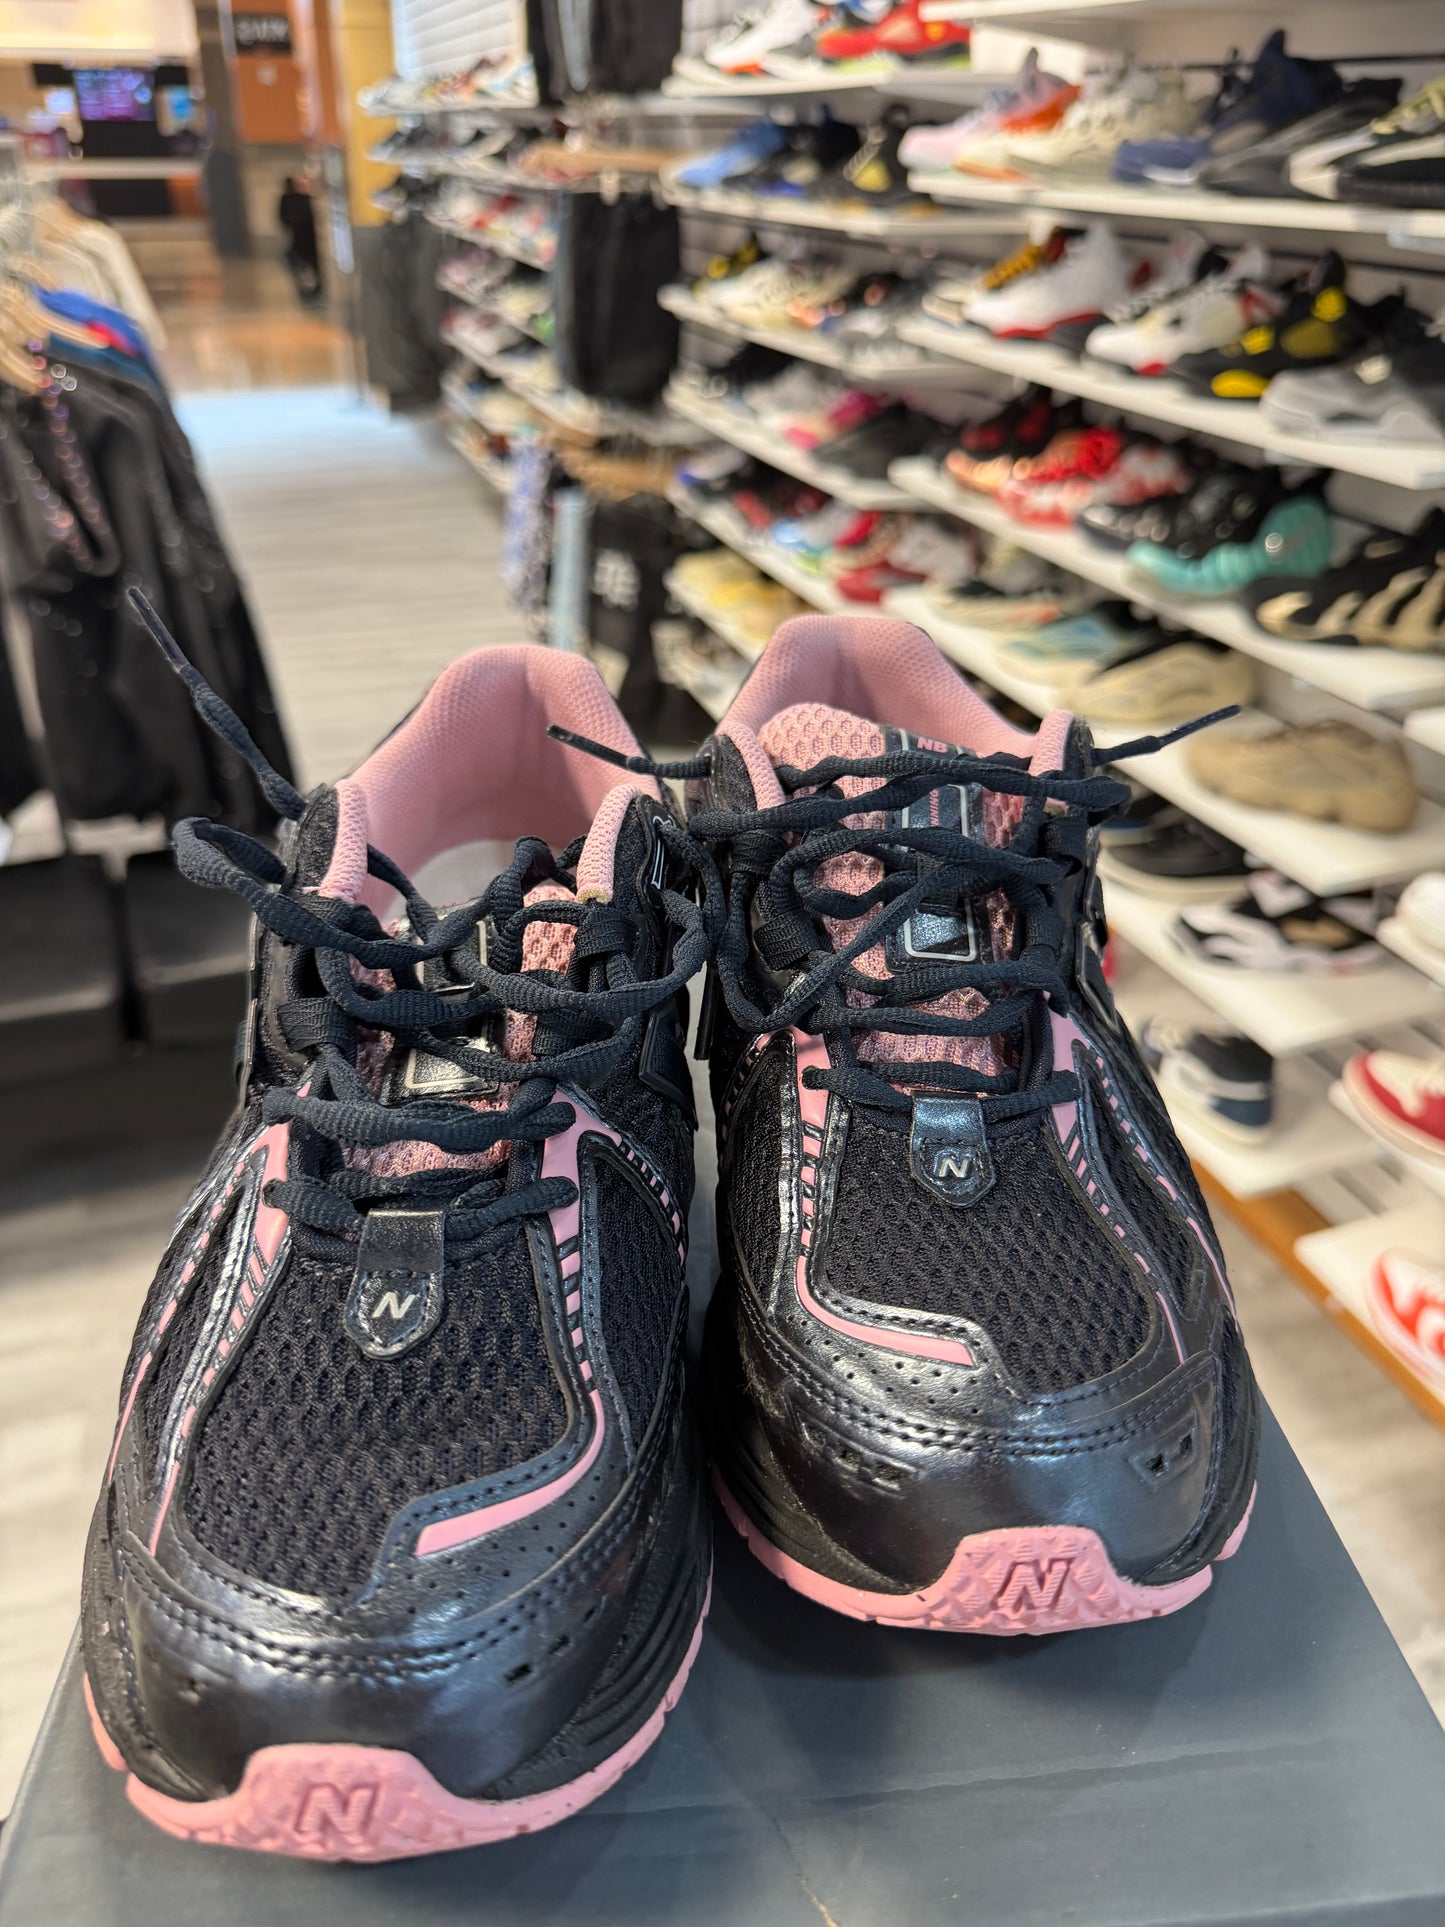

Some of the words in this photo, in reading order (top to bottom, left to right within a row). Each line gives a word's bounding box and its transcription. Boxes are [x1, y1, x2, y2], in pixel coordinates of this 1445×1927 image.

[917, 737, 947, 753] NB
[939, 1157, 969, 1178] N
[372, 1292, 417, 1319] N
[993, 1558, 1073, 1611] N
[296, 1782, 379, 1835] N
